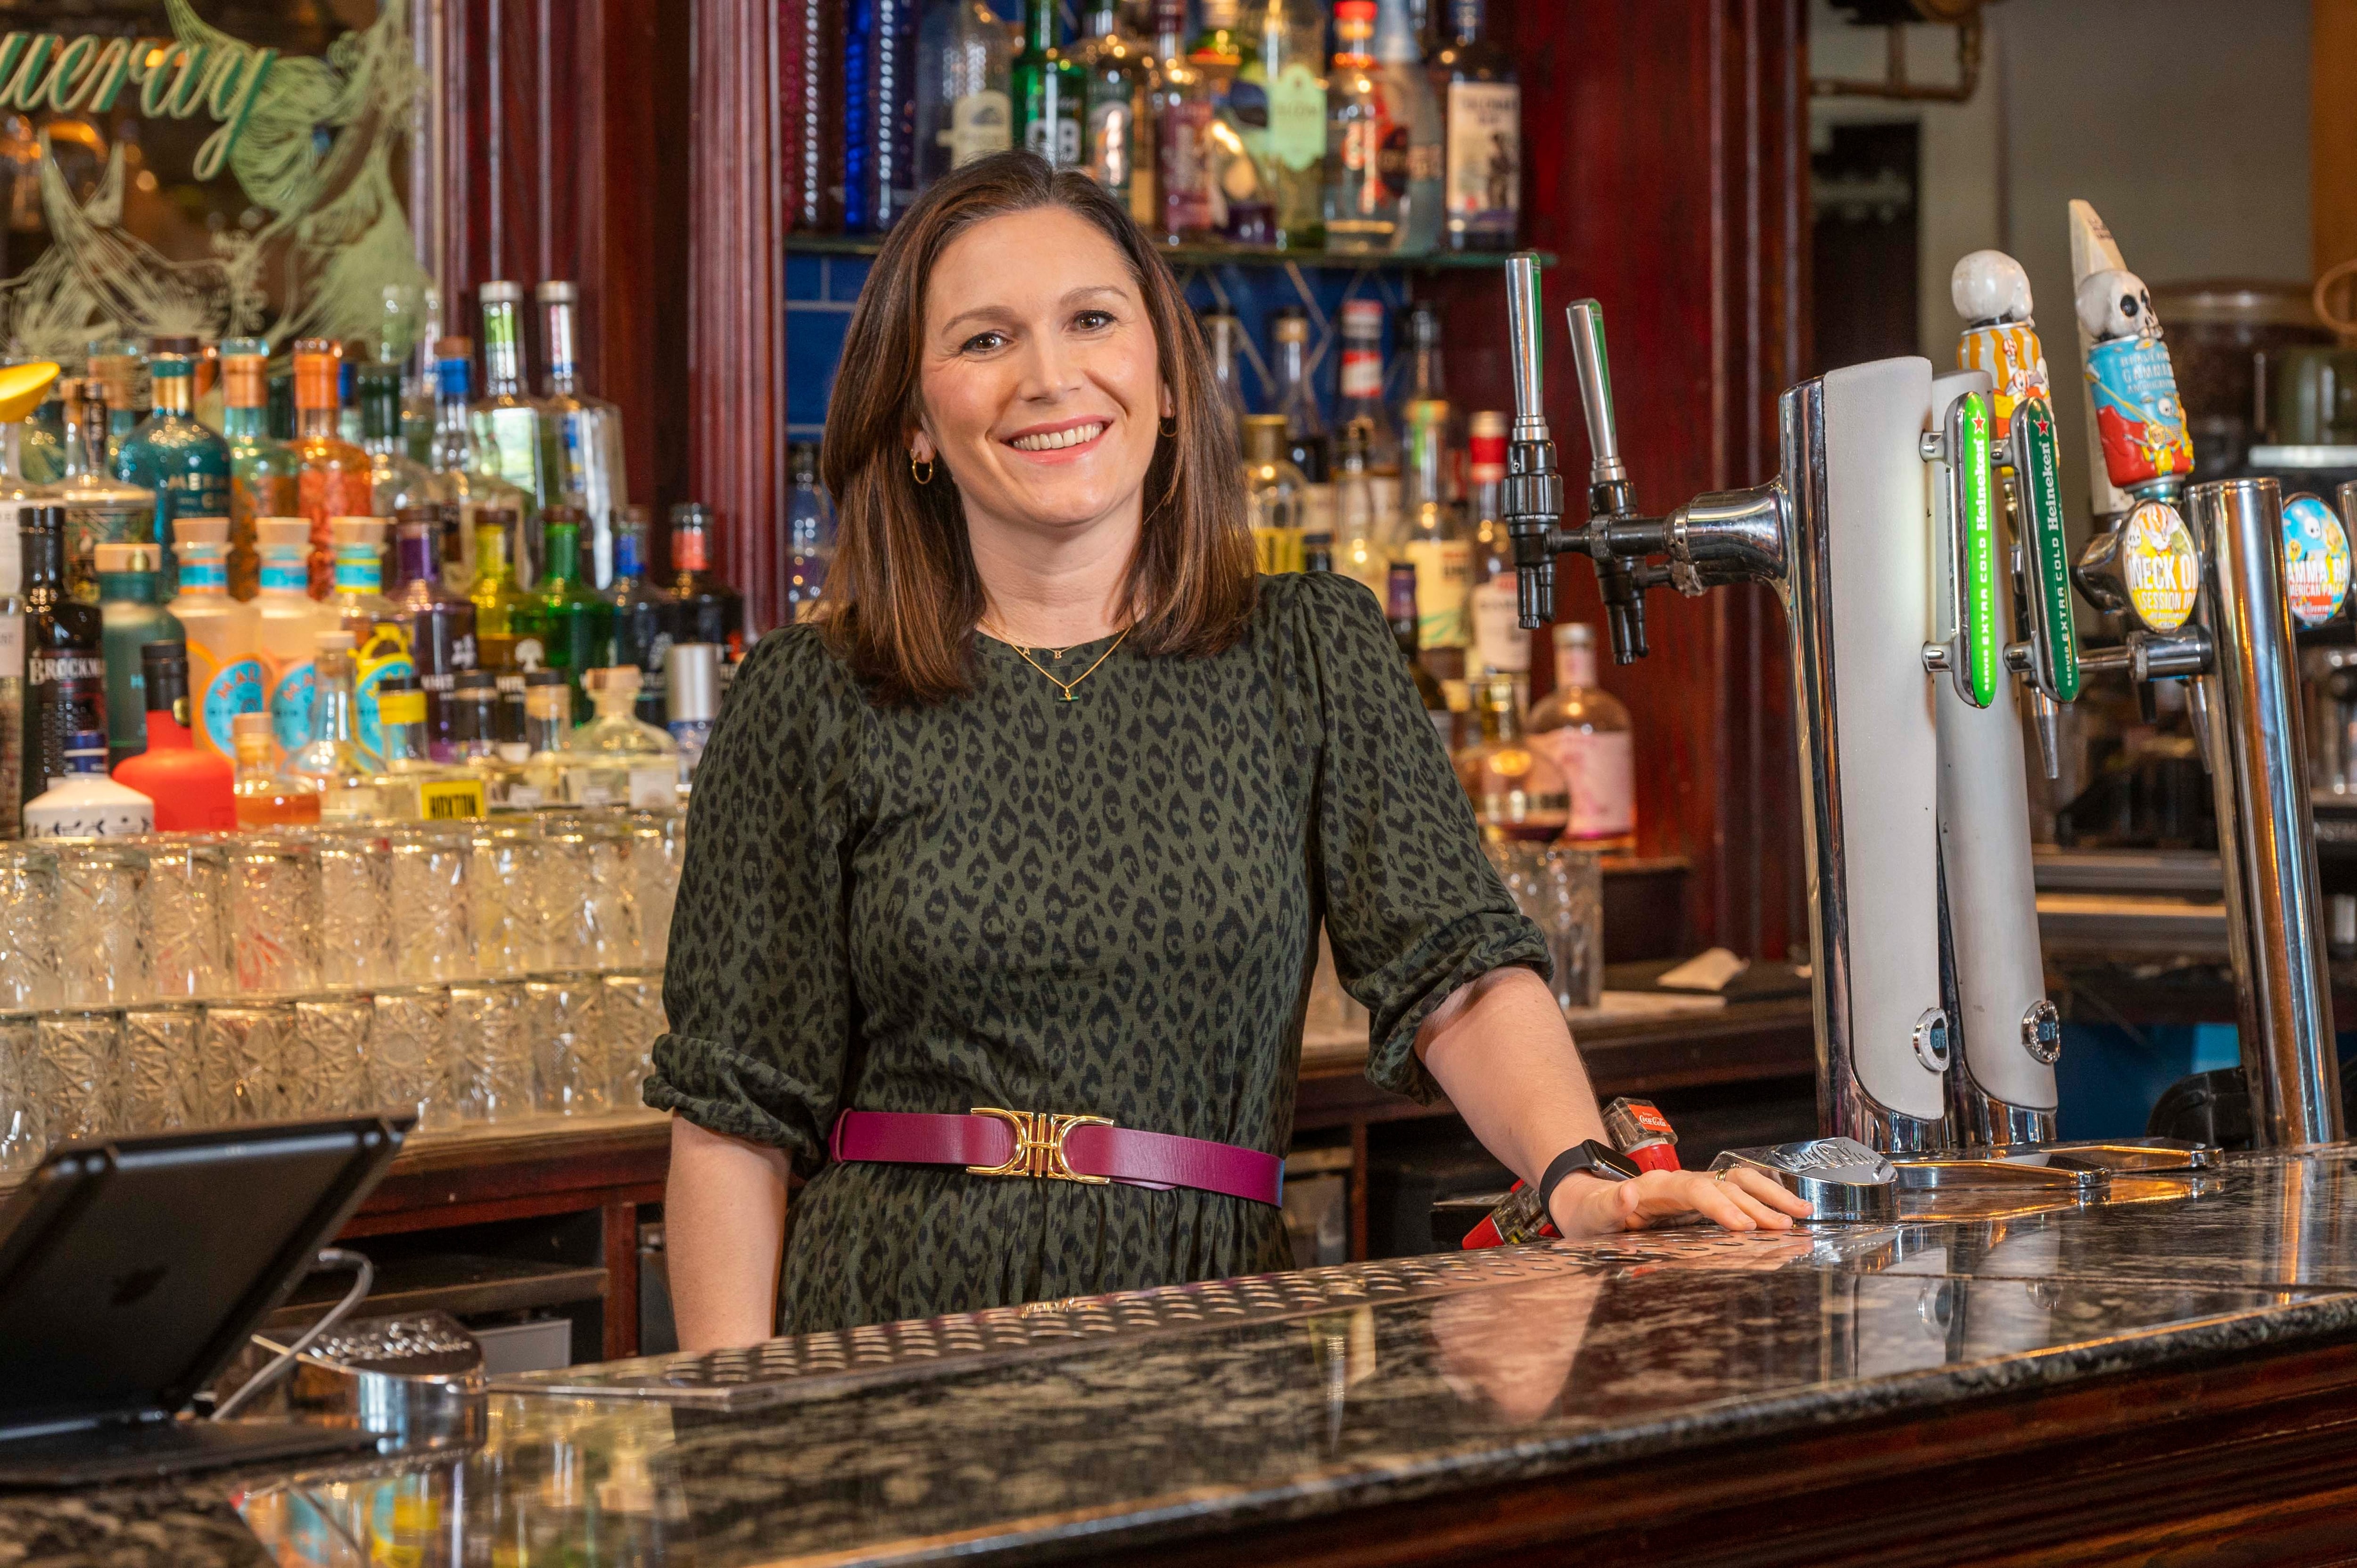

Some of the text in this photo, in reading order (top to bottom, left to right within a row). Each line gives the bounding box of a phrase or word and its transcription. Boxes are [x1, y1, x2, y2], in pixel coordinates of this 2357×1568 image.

[1975, 439, 1987, 531] Heineken
[2042, 441, 2059, 531] Heineken
[1978, 537, 1987, 583] COLD
[2052, 537, 2063, 582] COLD
[1980, 589, 1990, 646] EXTRA
[2057, 586, 2069, 642] EXTRA
